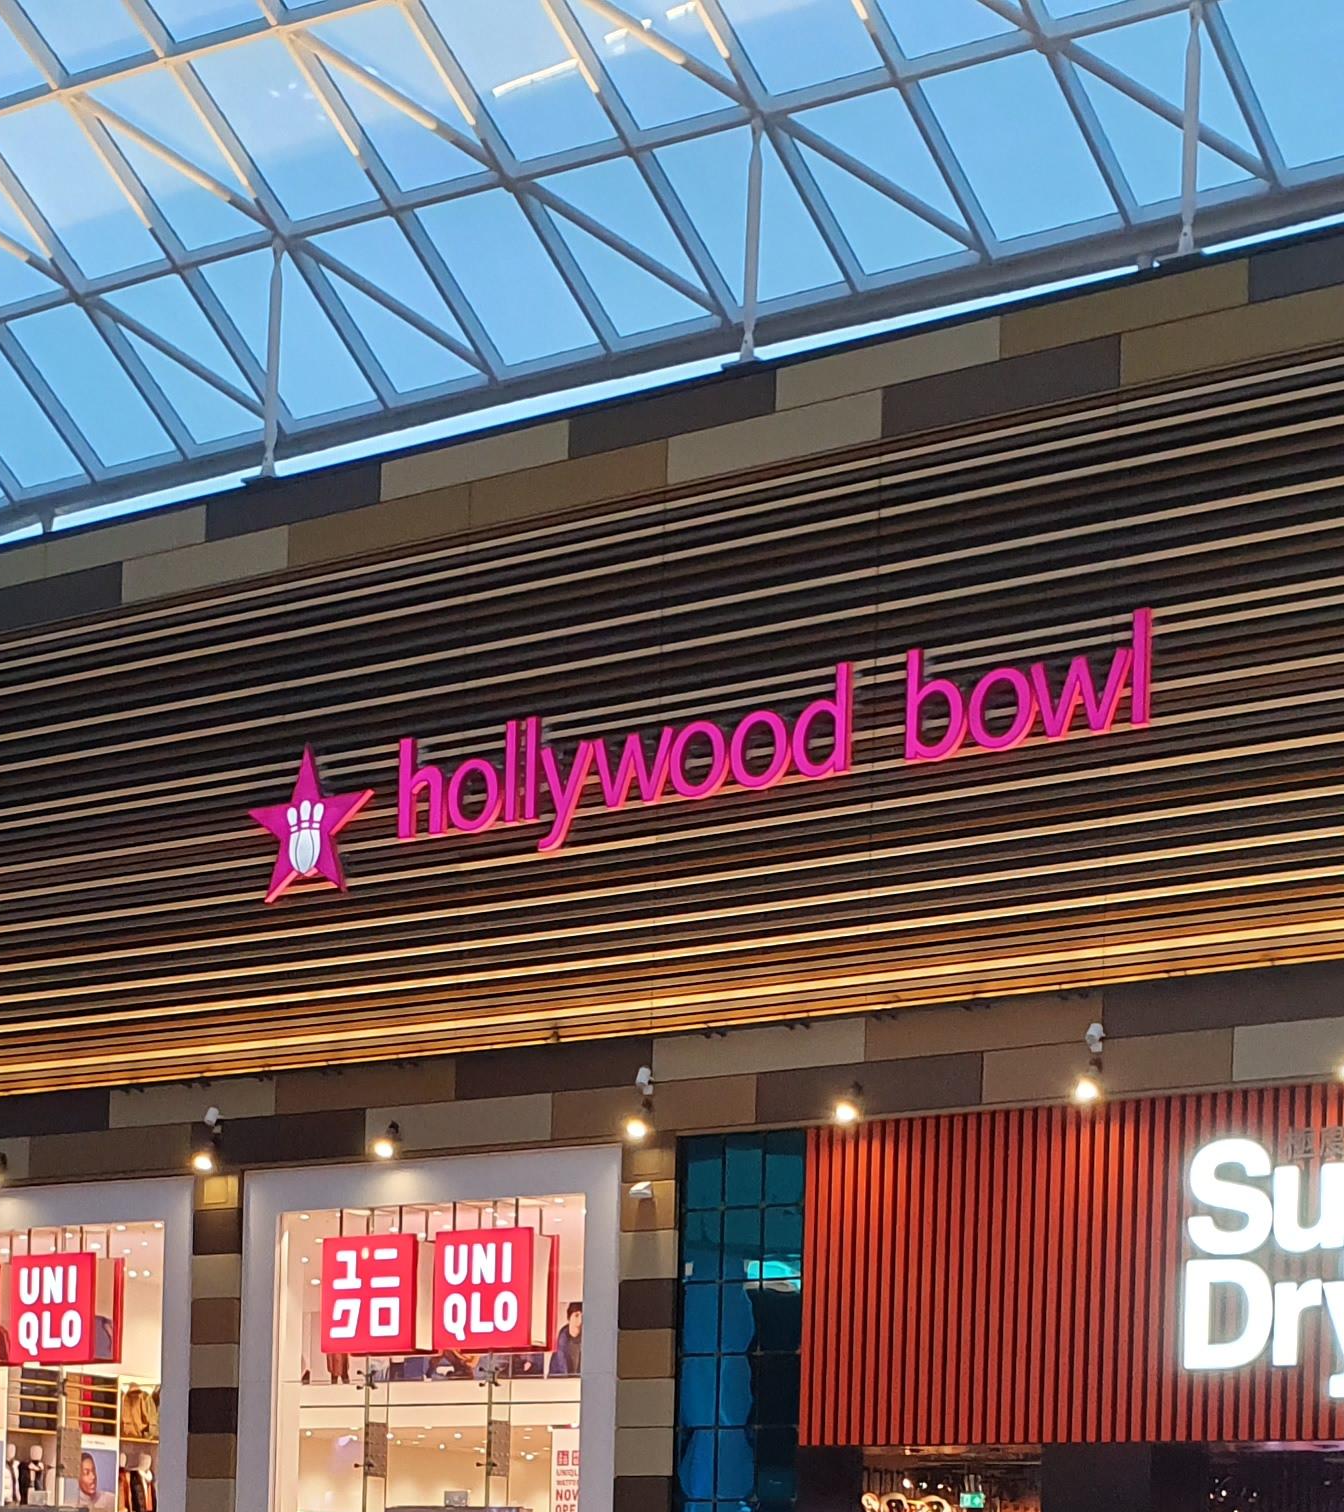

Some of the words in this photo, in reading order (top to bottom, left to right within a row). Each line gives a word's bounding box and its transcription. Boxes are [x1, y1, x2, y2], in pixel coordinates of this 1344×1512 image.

[398, 661, 855, 852] hollywood
[904, 607, 1153, 762] bowl
[18, 1264, 78, 1305] UNI
[443, 1241, 513, 1286] UNI
[17, 1308, 83, 1356] QLO
[442, 1290, 519, 1341] QLO
